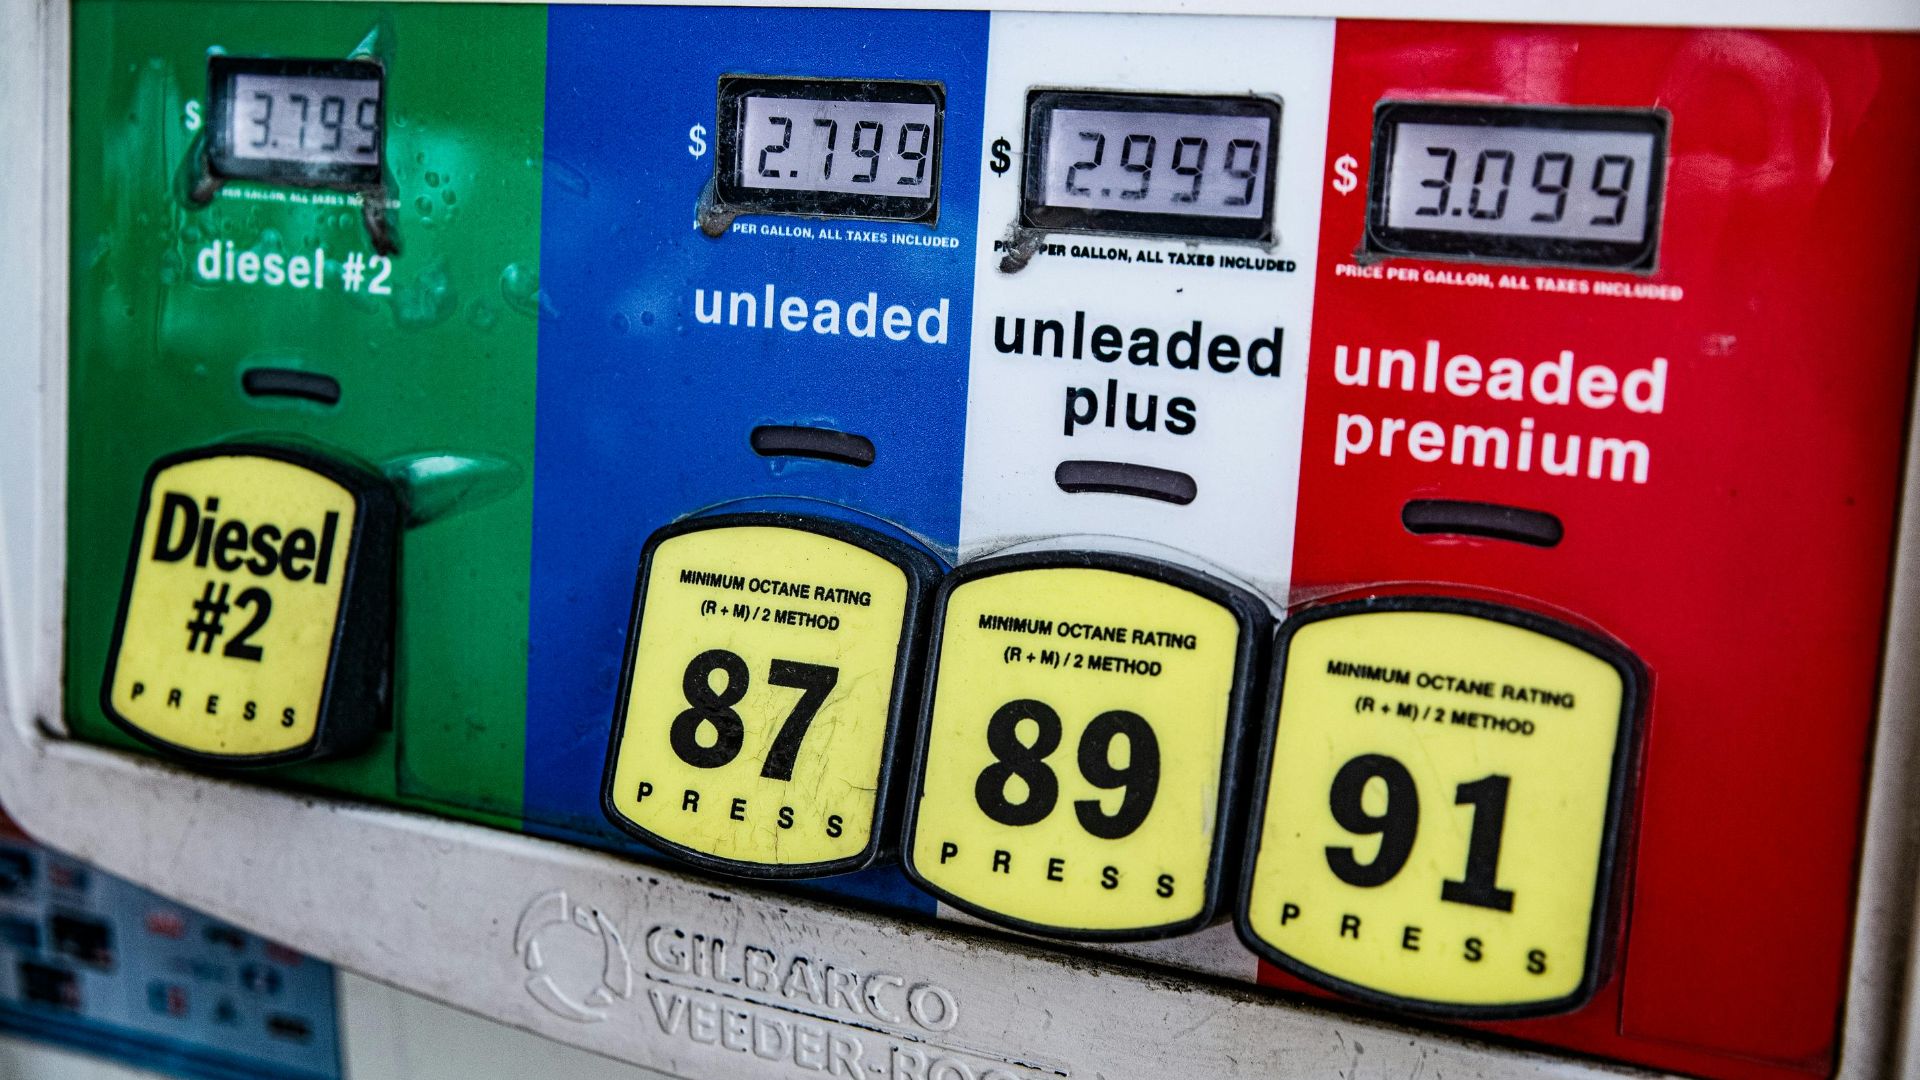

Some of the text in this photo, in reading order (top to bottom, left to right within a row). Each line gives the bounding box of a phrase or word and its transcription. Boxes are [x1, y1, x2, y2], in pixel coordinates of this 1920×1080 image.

[252, 91, 379, 153] 3.799
[688, 116, 931, 186] $ 2.799
[990, 132, 1261, 207] $ 2.999
[1332, 146, 1635, 226] $ 3.099
[733, 223, 757, 235] PER
[761, 225, 815, 240] GALLON,
[819, 228, 842, 241] ALL
[846, 231, 887, 244] TAXES
[892, 234, 960, 248] INCLUDED
[1039, 243, 1066, 257] PER
[1071, 245, 1132, 263] GALLON,
[1136, 250, 1163, 263] ALL
[1169, 252, 1215, 267] TAXES
[1220, 255, 1296, 272] INCLUDED
[197, 240, 392, 294] diesel #2
[1336, 264, 1684, 301] PRICE PER GALLON, ALL TAXES INCLUDED
[694, 284, 950, 344] unleaded
[993, 311, 1284, 378] unleaded
[1064, 378, 1197, 437] plus
[1333, 340, 1668, 414] unleaded
[1334, 413, 1650, 484] premium
[152, 491, 339, 585] Diesel
[680, 569, 871, 607] MINIMUM OCTANE RATING
[186, 581, 272, 662] #2
[774, 609, 840, 631] METHOD
[978, 614, 1197, 650] MINIMUM OCTANE RATING
[1088, 655, 1162, 677] METHOD
[1327, 660, 1575, 709] MINIMUM OCTANE RATING
[130, 682, 295, 728] PRESS
[670, 649, 839, 782] 87
[1451, 709, 1536, 736] METHOD
[974, 698, 1161, 840] 89
[637, 782, 843, 838] PRESS
[1325, 753, 1516, 913] 91
[940, 842, 1175, 899] PRESS
[1281, 903, 1548, 976] PRESS
[645, 925, 960, 1033] GILBARCO
[647, 988, 1023, 1080] VEEDER-R
